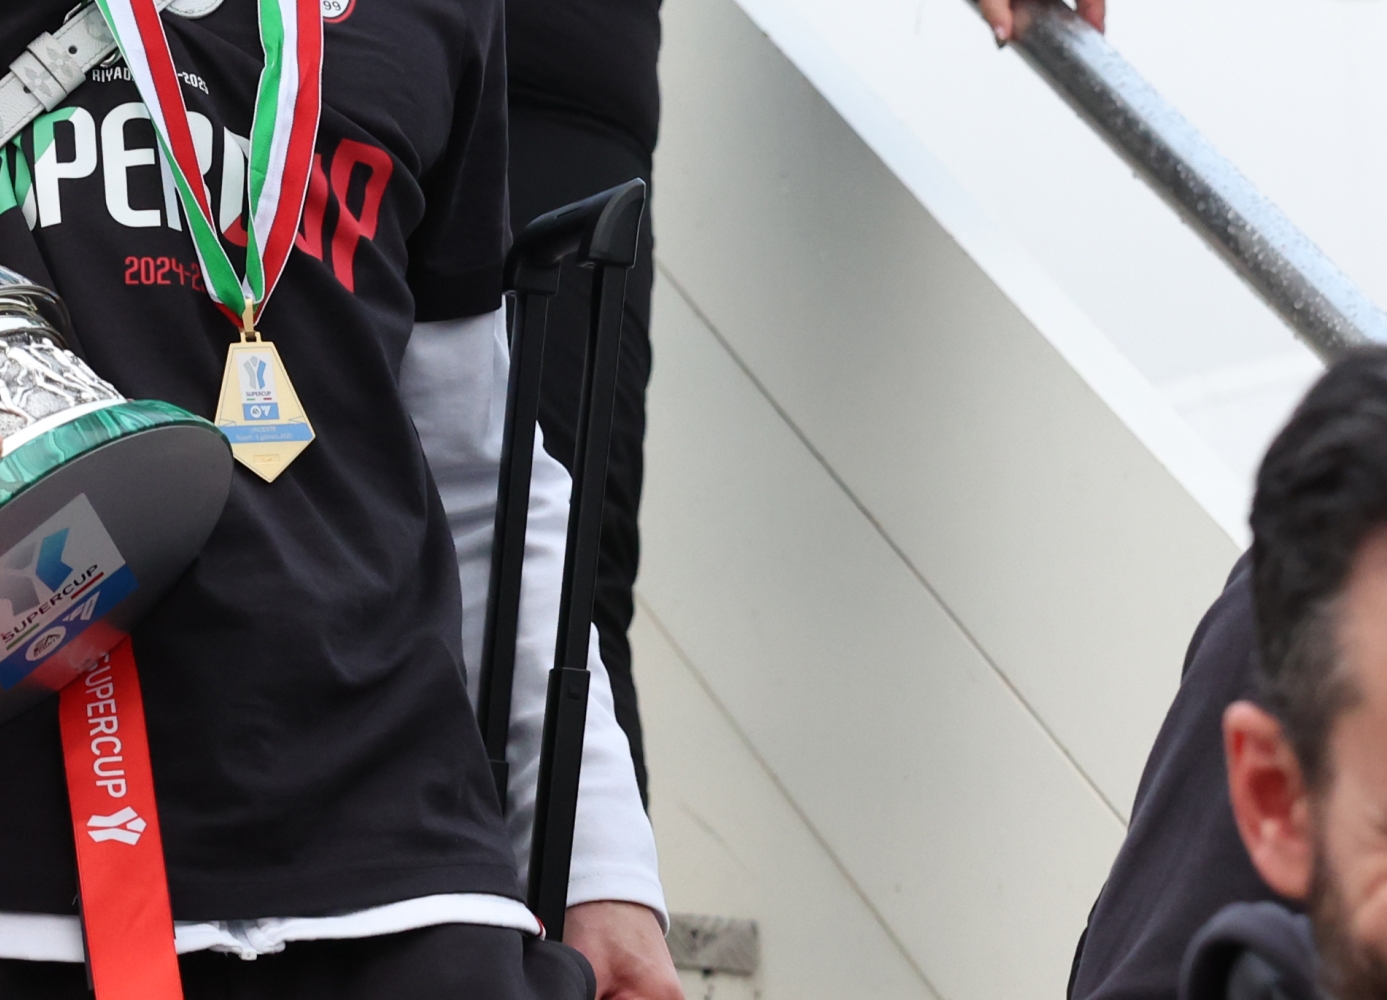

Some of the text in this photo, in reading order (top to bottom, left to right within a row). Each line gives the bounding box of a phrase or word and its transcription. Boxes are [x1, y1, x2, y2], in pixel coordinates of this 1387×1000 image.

[92, 66, 133, 83] RIYAD
[124, 255, 207, 292] 2024-2
[3, 563, 99, 644] SUPERCUP
